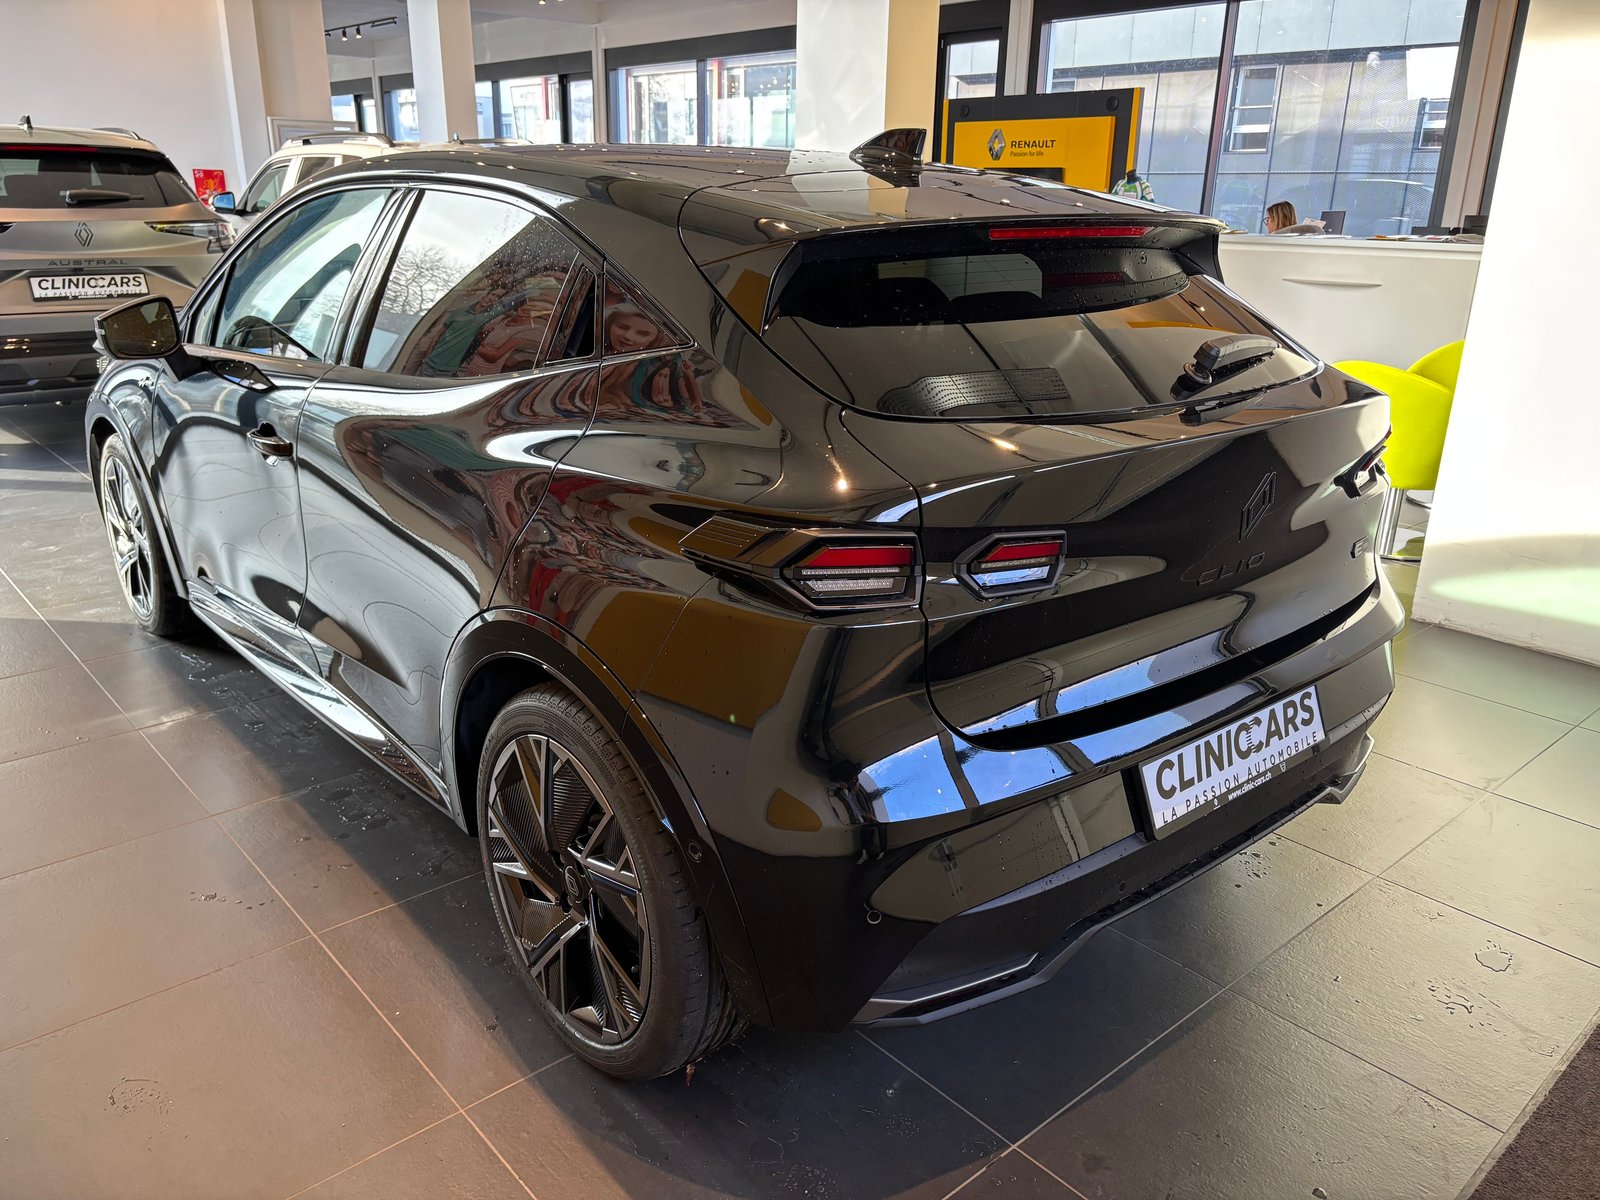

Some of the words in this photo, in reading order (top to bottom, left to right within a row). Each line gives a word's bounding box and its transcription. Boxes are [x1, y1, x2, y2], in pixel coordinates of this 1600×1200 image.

[1010, 140, 1056, 149] RENAULT
[48, 259, 129, 267] AUSTRAL
[1196, 551, 1266, 587] CLIO
[1162, 806, 1178, 824] LA
[1185, 773, 1240, 812] PASSION
[1247, 731, 1319, 779] AUTOMOBILE
[1227, 771, 1273, 801] www.clinic-cars.ch
